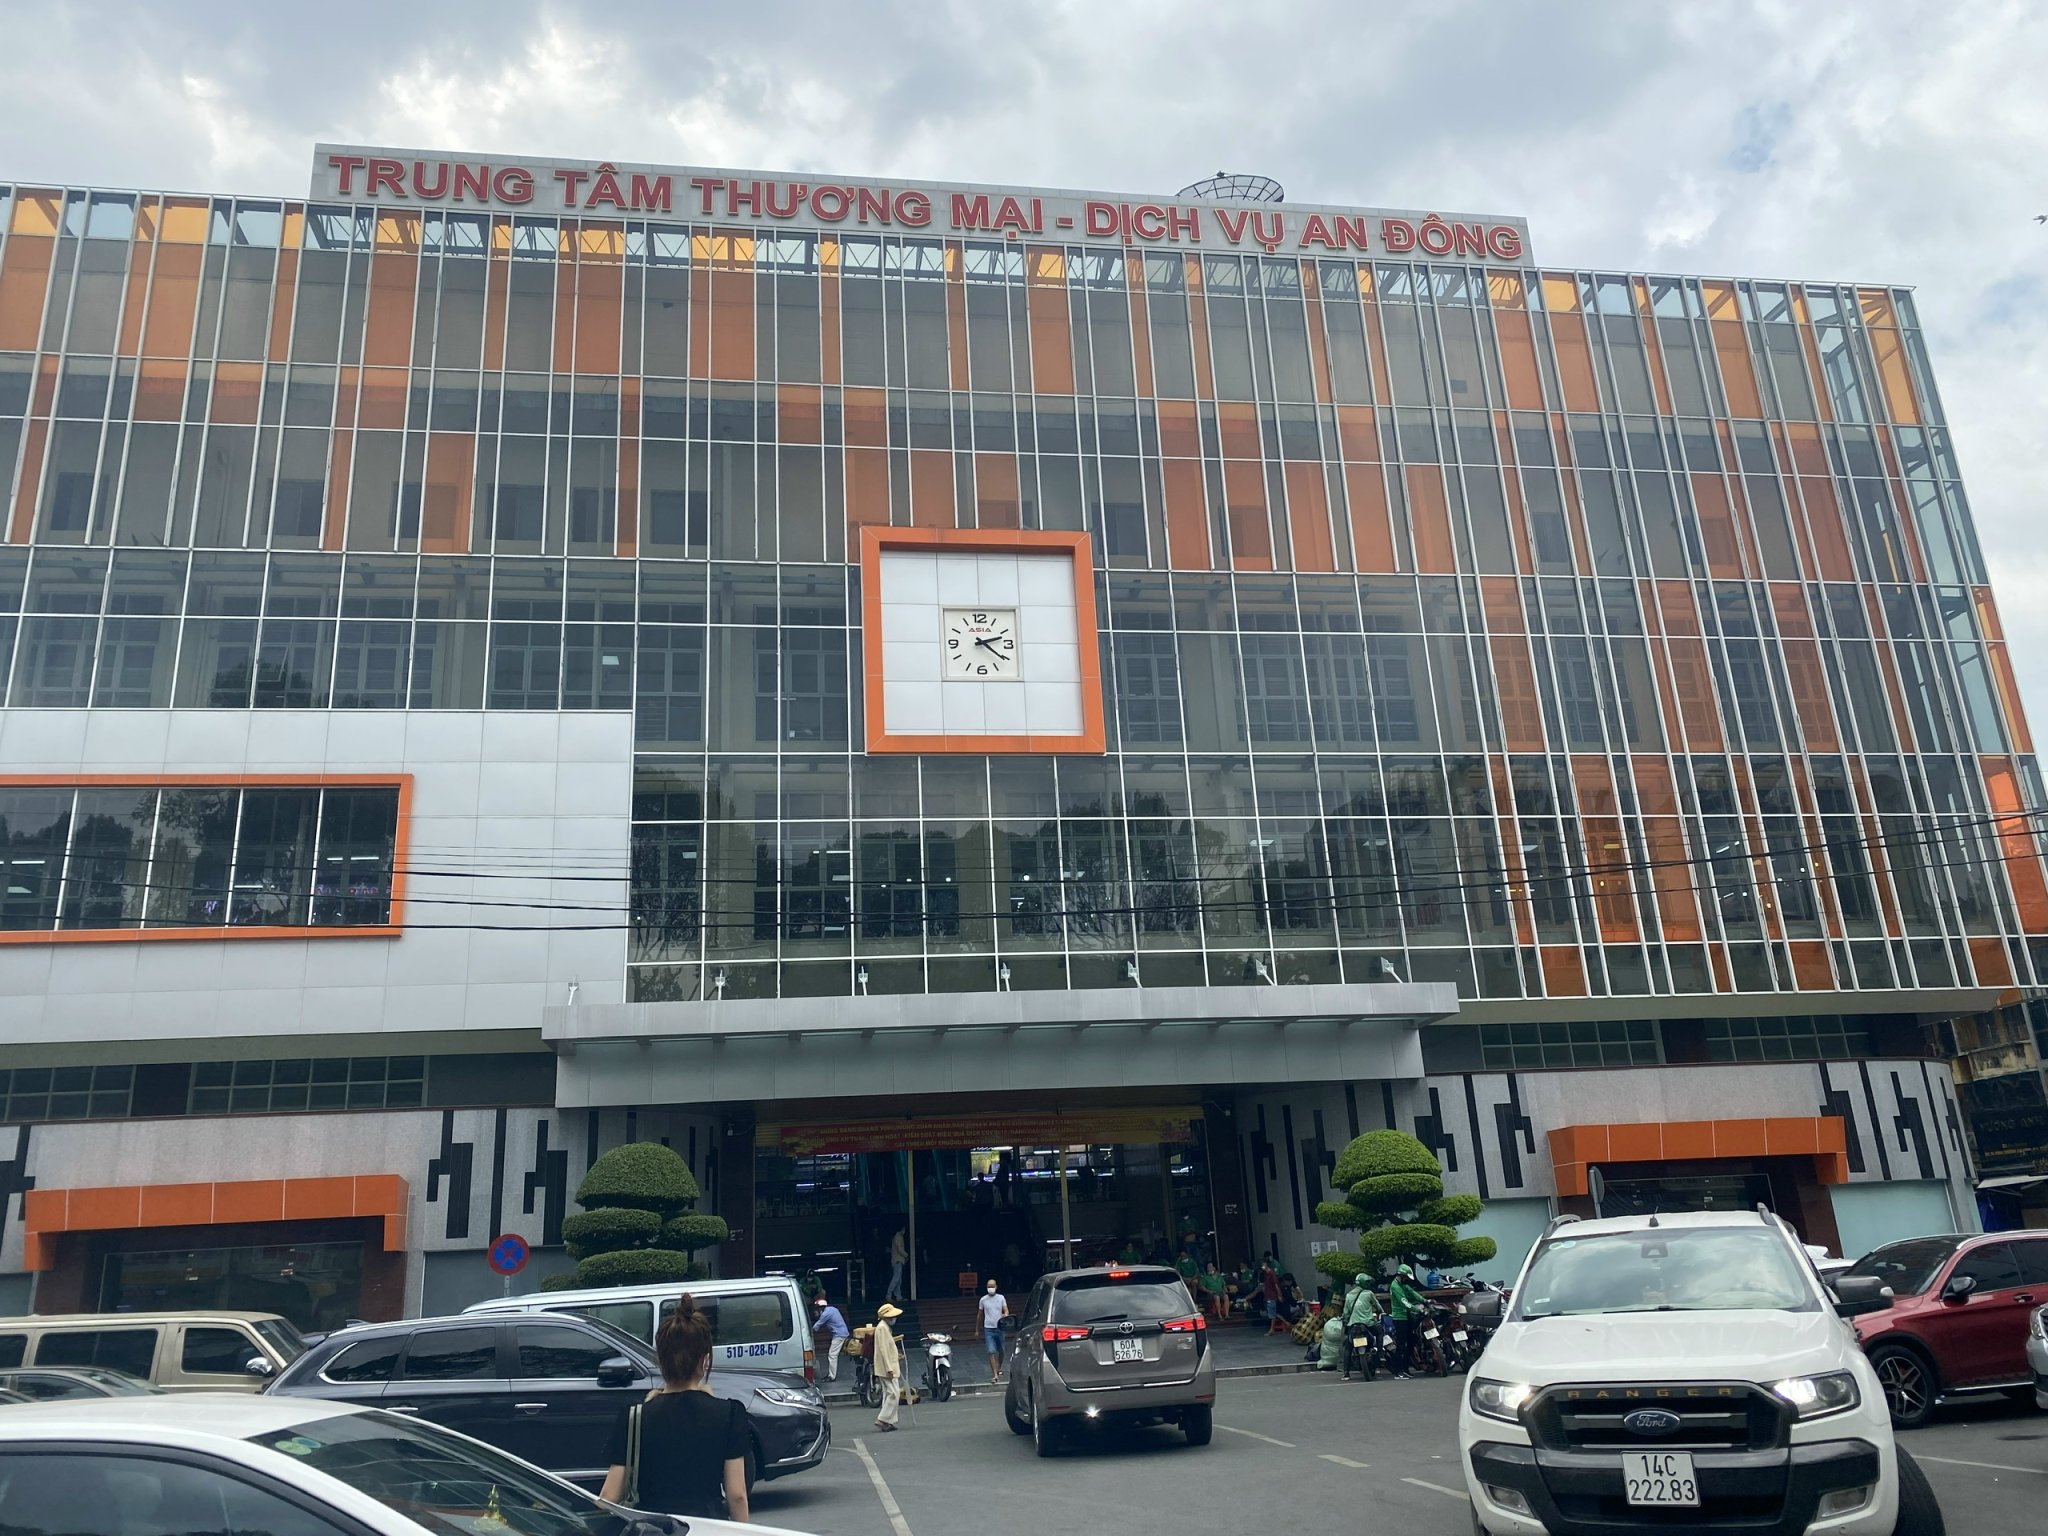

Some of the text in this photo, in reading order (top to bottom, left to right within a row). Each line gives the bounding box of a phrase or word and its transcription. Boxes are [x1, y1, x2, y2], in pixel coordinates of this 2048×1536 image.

[328, 155, 535, 203] TRUNG
[553, 163, 673, 212] TÂM
[691, 177, 933, 227] THƯƠNG
[950, 193, 1044, 240] MẠI
[1085, 201, 1202, 246] DỊCH
[1214, 208, 1287, 254] VỤ
[1300, 212, 1369, 250] AN
[1381, 212, 1524, 259] ĐÔNG
[972, 613, 987, 623] 12
[948, 639, 959, 649] 9
[1003, 640, 1014, 649] 3
[977, 665, 988, 675] 6
[1120, 1339, 1136, 1350] 60A
[1567, 1387, 1733, 1398] RANGER
[1636, 1414, 1667, 1427] Ford
[1641, 1455, 1677, 1477] 14C
[1628, 1479, 1696, 1501] 222.83
